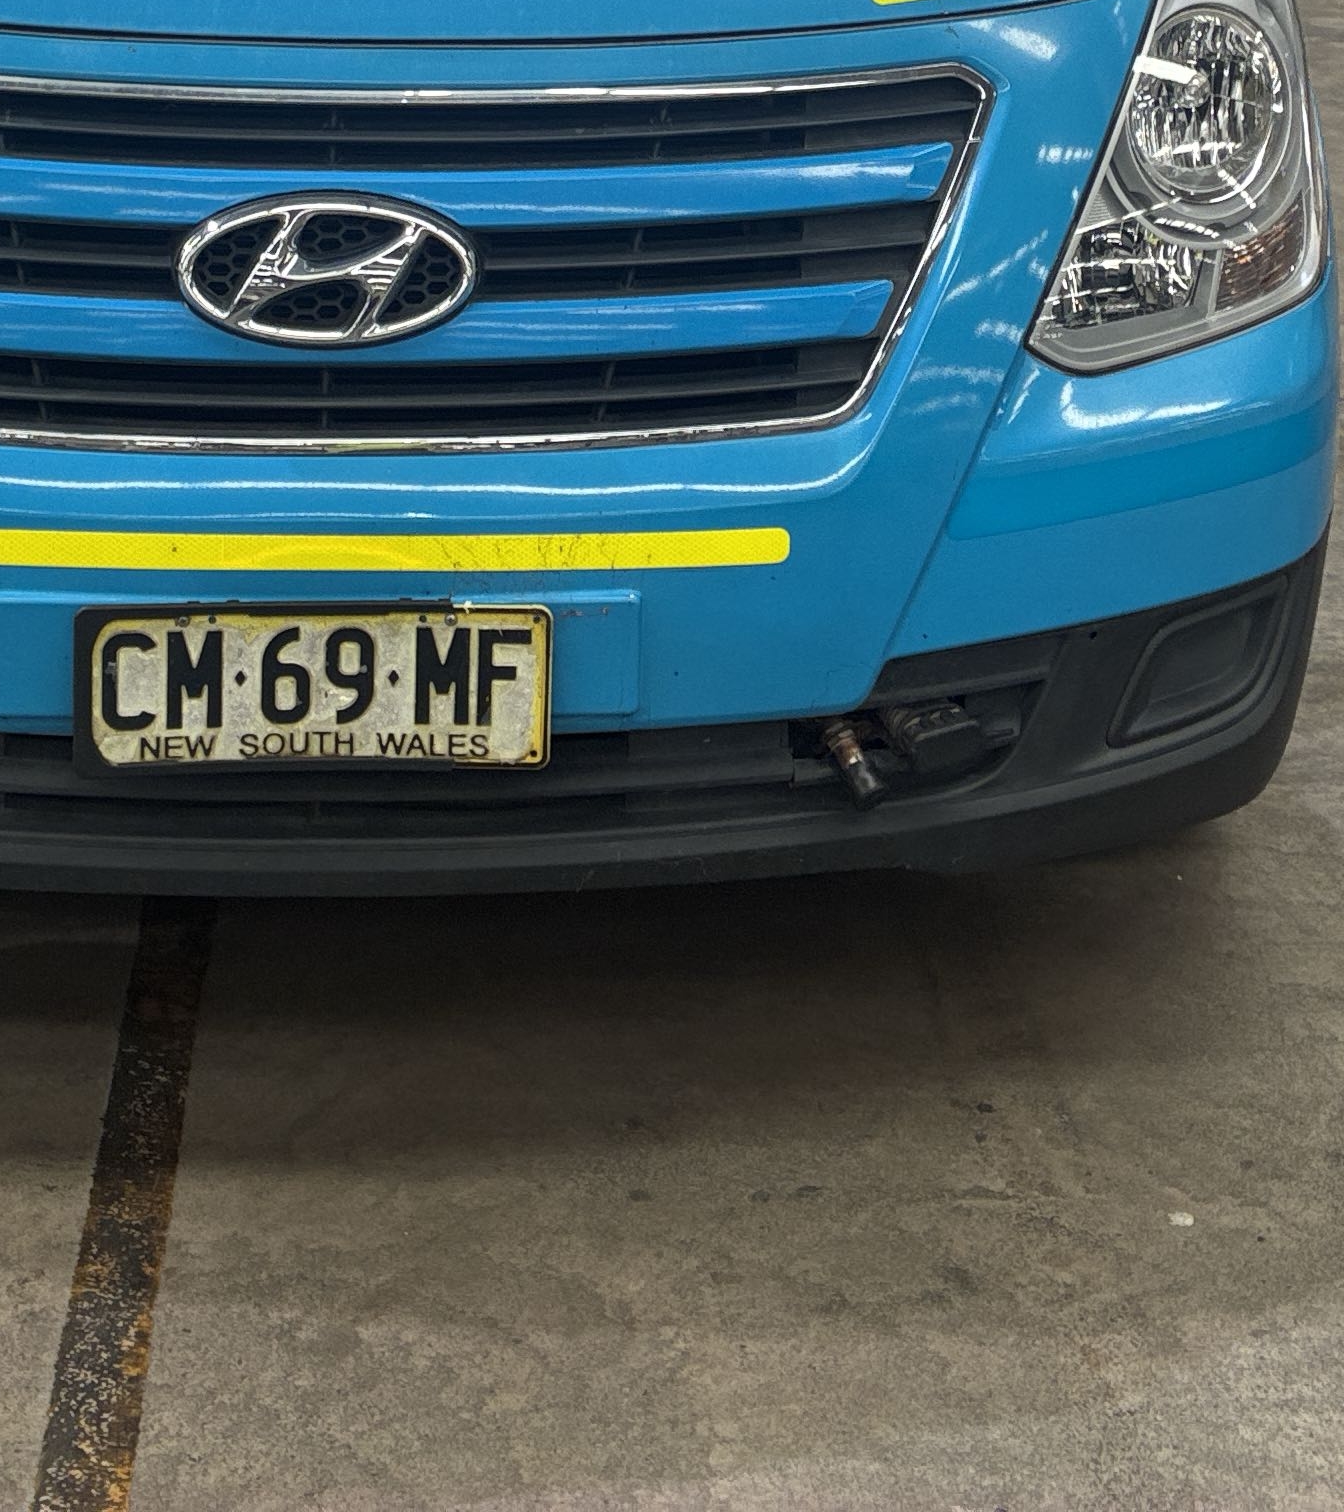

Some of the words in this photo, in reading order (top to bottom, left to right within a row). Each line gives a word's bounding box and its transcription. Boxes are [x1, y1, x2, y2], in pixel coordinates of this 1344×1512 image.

[100, 630, 224, 732] CM
[261, 626, 376, 725] 69
[414, 627, 533, 727] MF
[139, 734, 215, 760] NEW
[239, 731, 355, 757] SOUTH
[376, 732, 490, 758] WALES
